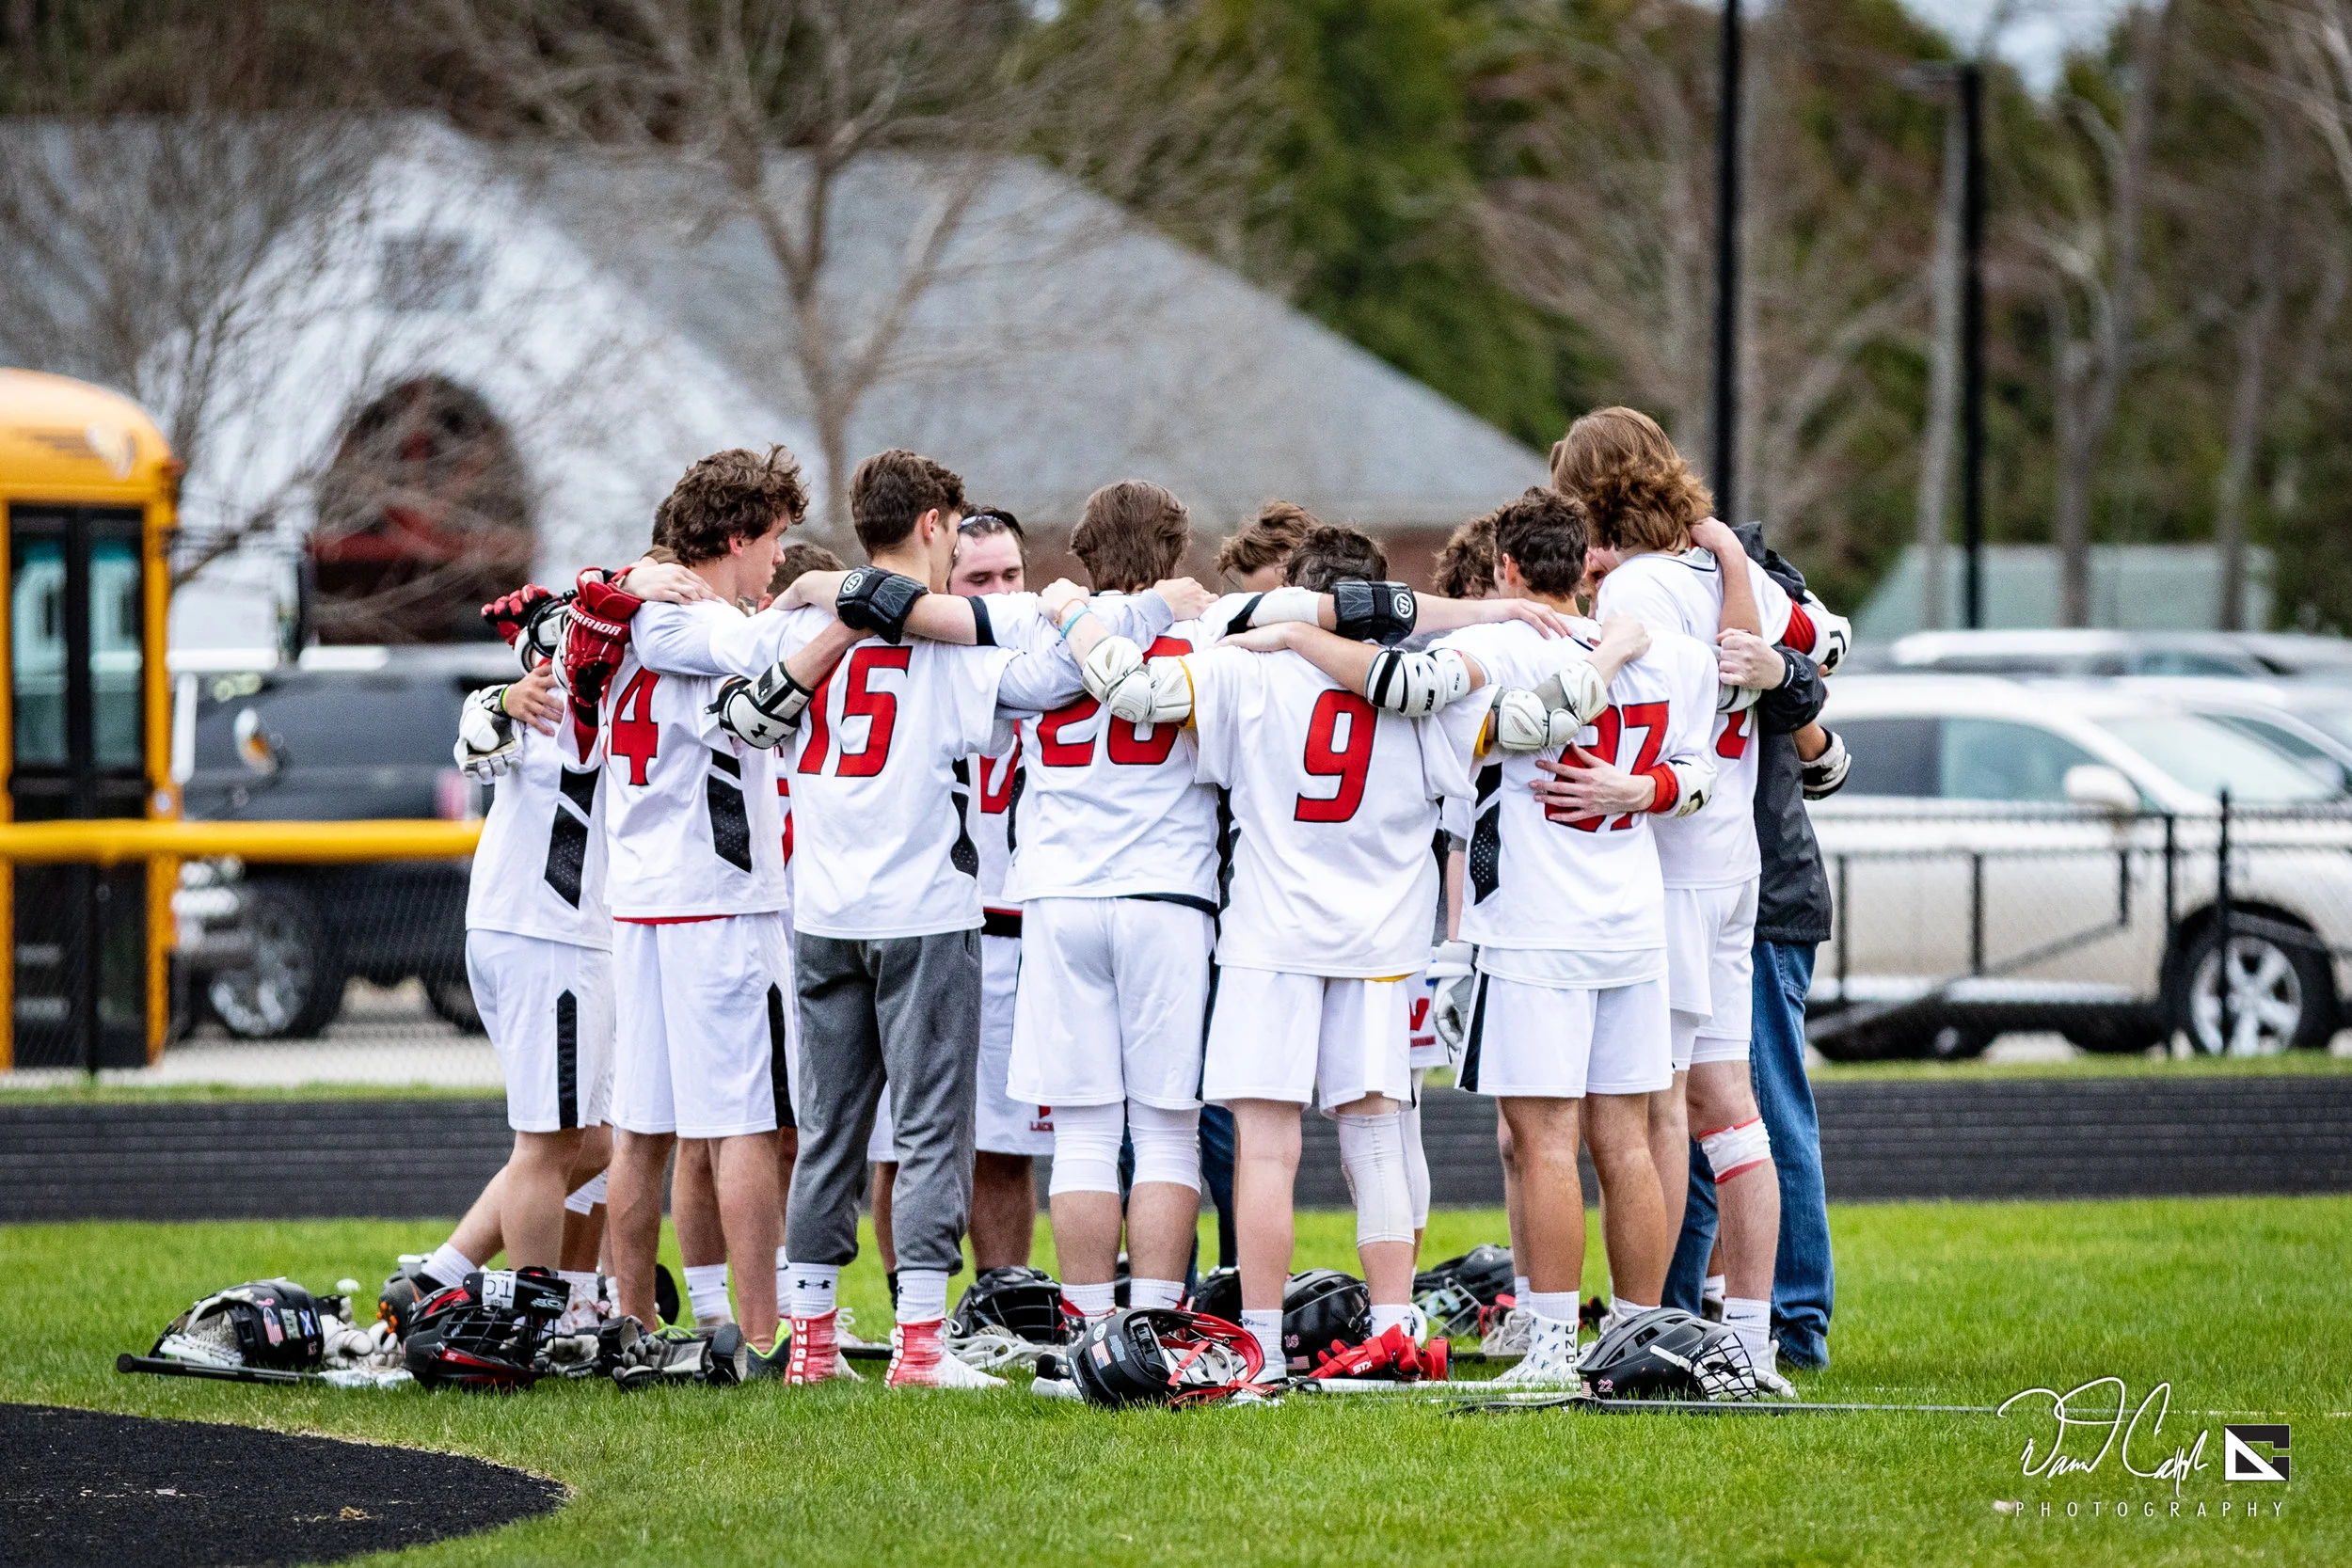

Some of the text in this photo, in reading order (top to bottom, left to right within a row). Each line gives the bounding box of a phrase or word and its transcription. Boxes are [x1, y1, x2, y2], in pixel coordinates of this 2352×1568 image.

[567, 605, 622, 637] ARRIOR
[798, 645, 914, 777] 15
[1294, 689, 1379, 824] 9
[1352, 1360, 1374, 1374] STX
[1597, 1378, 1614, 1393] 22
